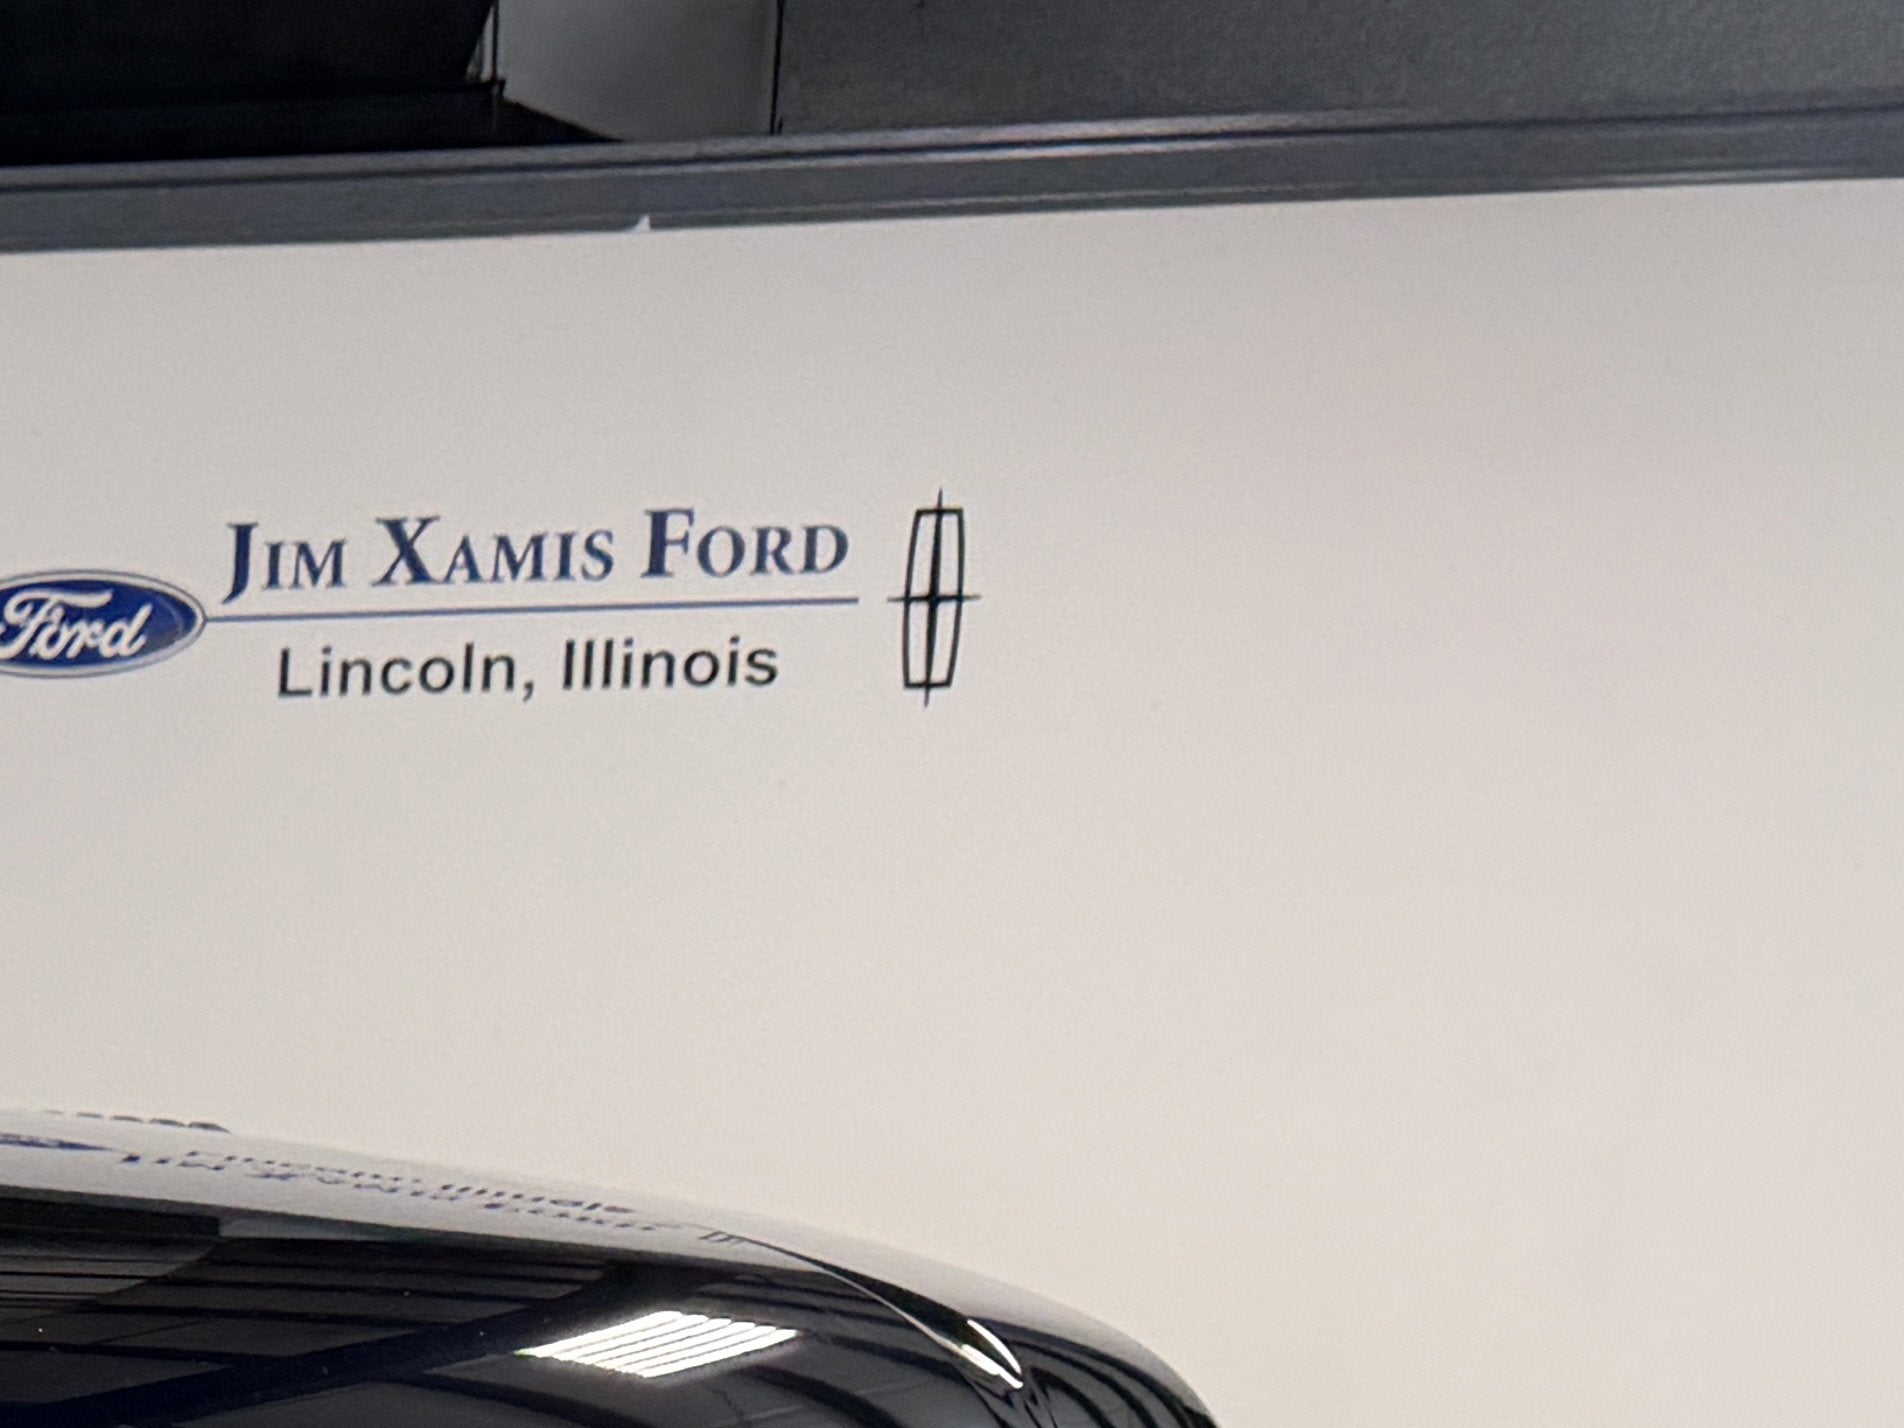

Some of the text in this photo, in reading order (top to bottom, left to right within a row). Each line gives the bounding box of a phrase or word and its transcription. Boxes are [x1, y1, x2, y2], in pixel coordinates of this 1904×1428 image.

[221, 506, 849, 605] JIM XAMIS FORD
[277, 634, 779, 703] Lincoln, Illinois
